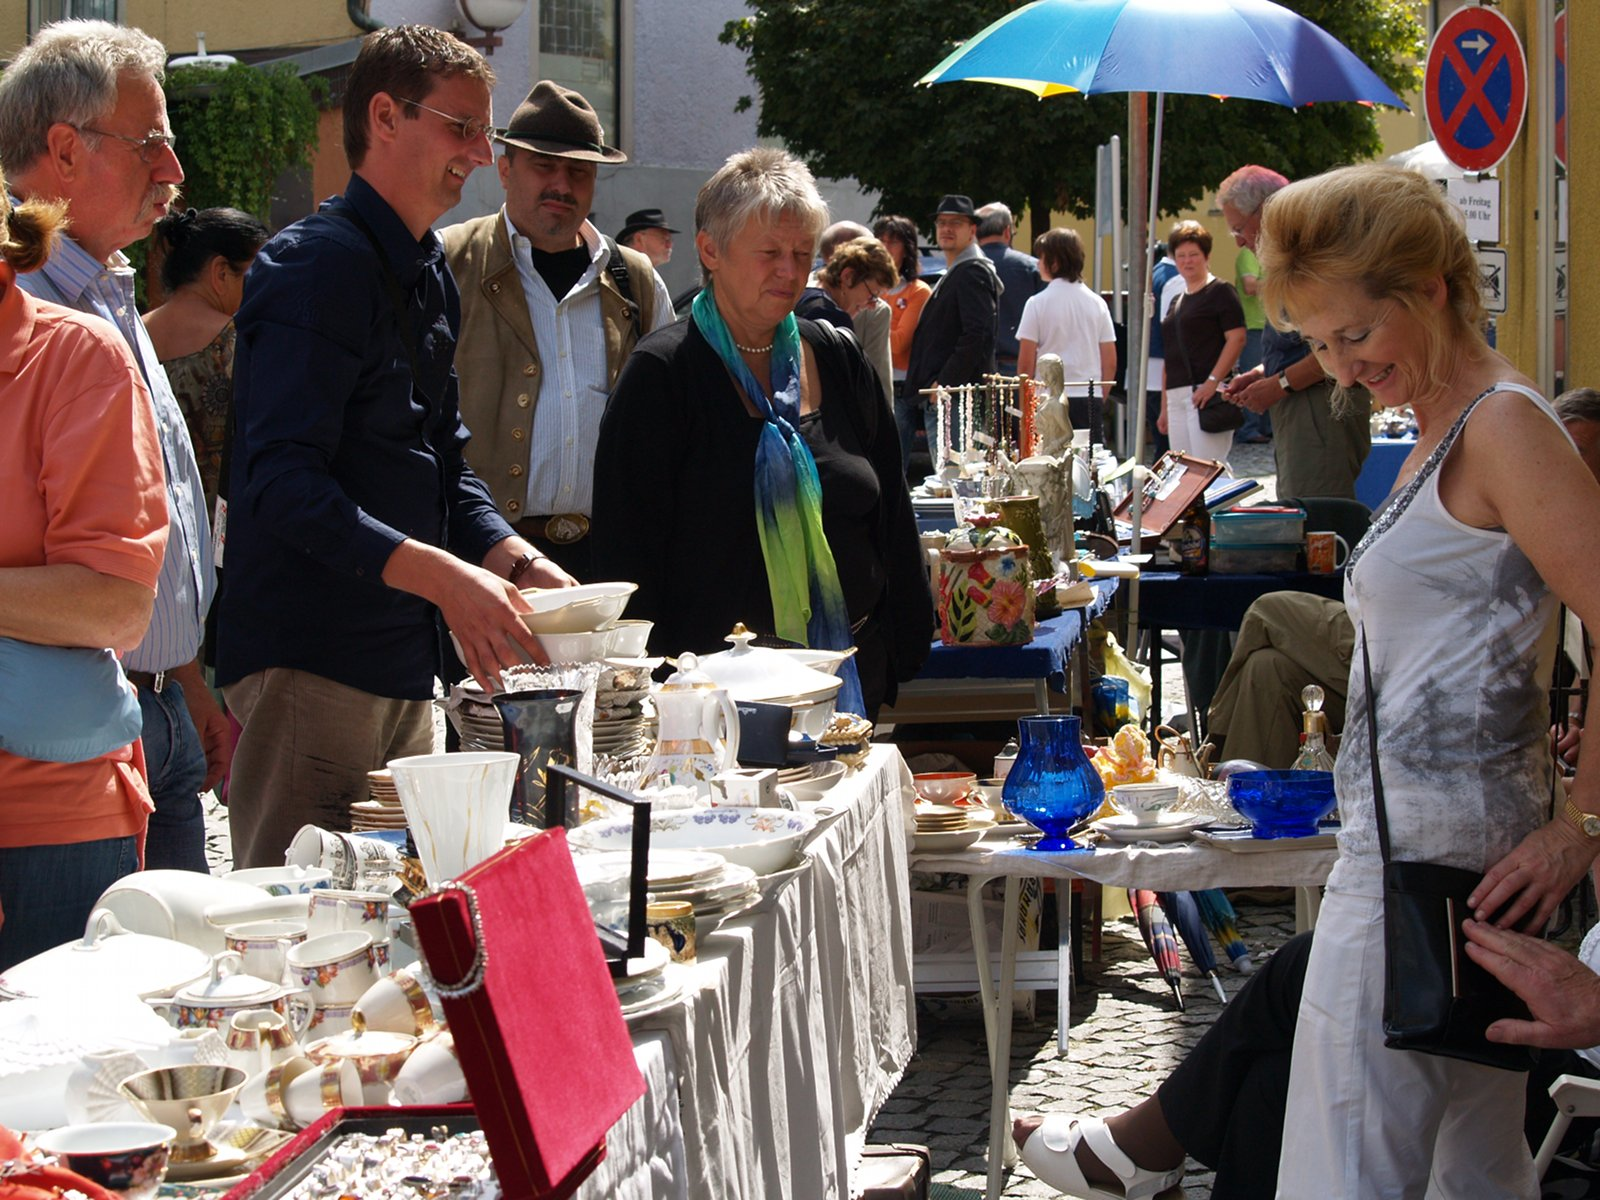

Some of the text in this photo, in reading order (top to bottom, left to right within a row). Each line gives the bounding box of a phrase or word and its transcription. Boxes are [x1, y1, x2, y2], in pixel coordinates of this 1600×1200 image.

[1459, 196, 1491, 208] ab Freitag
[1478, 210, 1491, 220] Uhr
